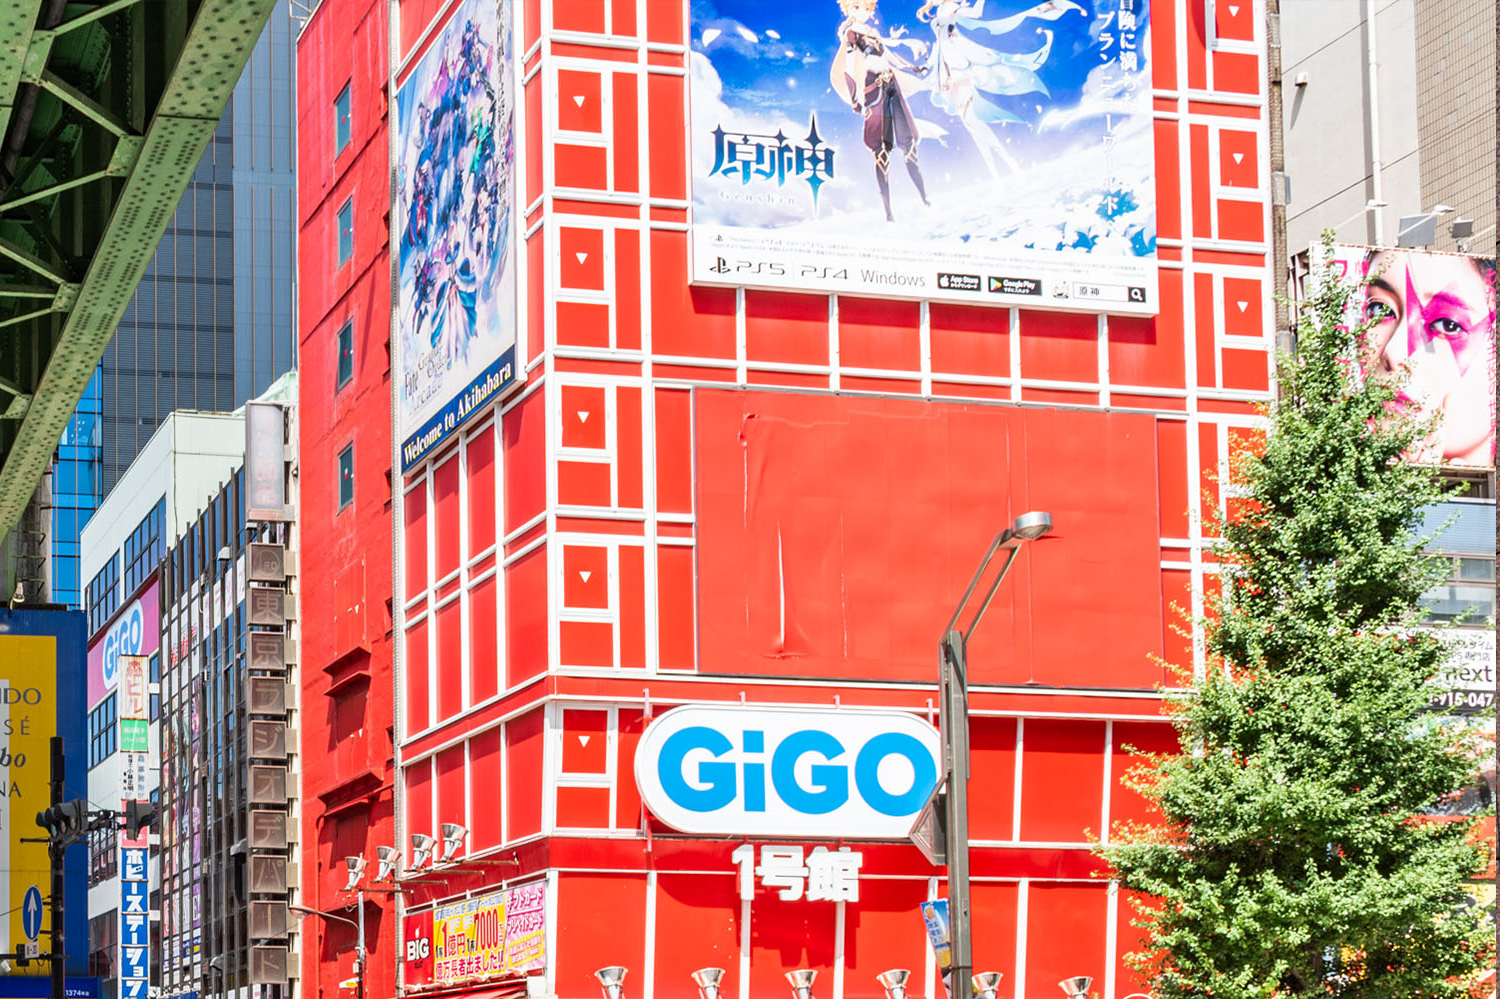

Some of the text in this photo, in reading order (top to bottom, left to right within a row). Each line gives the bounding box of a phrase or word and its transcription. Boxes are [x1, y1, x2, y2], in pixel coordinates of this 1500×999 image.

[708, 113, 835, 213] 原神
[736, 260, 926, 288] PS5 PS4 Windows
[403, 363, 512, 465] Welcome to Akihabara
[252, 591, 286, 980] 東京ラジオデパート
[657, 725, 937, 817] GiGO
[732, 844, 863, 903] 1号館
[125, 849, 144, 998] ホビーステーション
[406, 937, 430, 962] BIG
